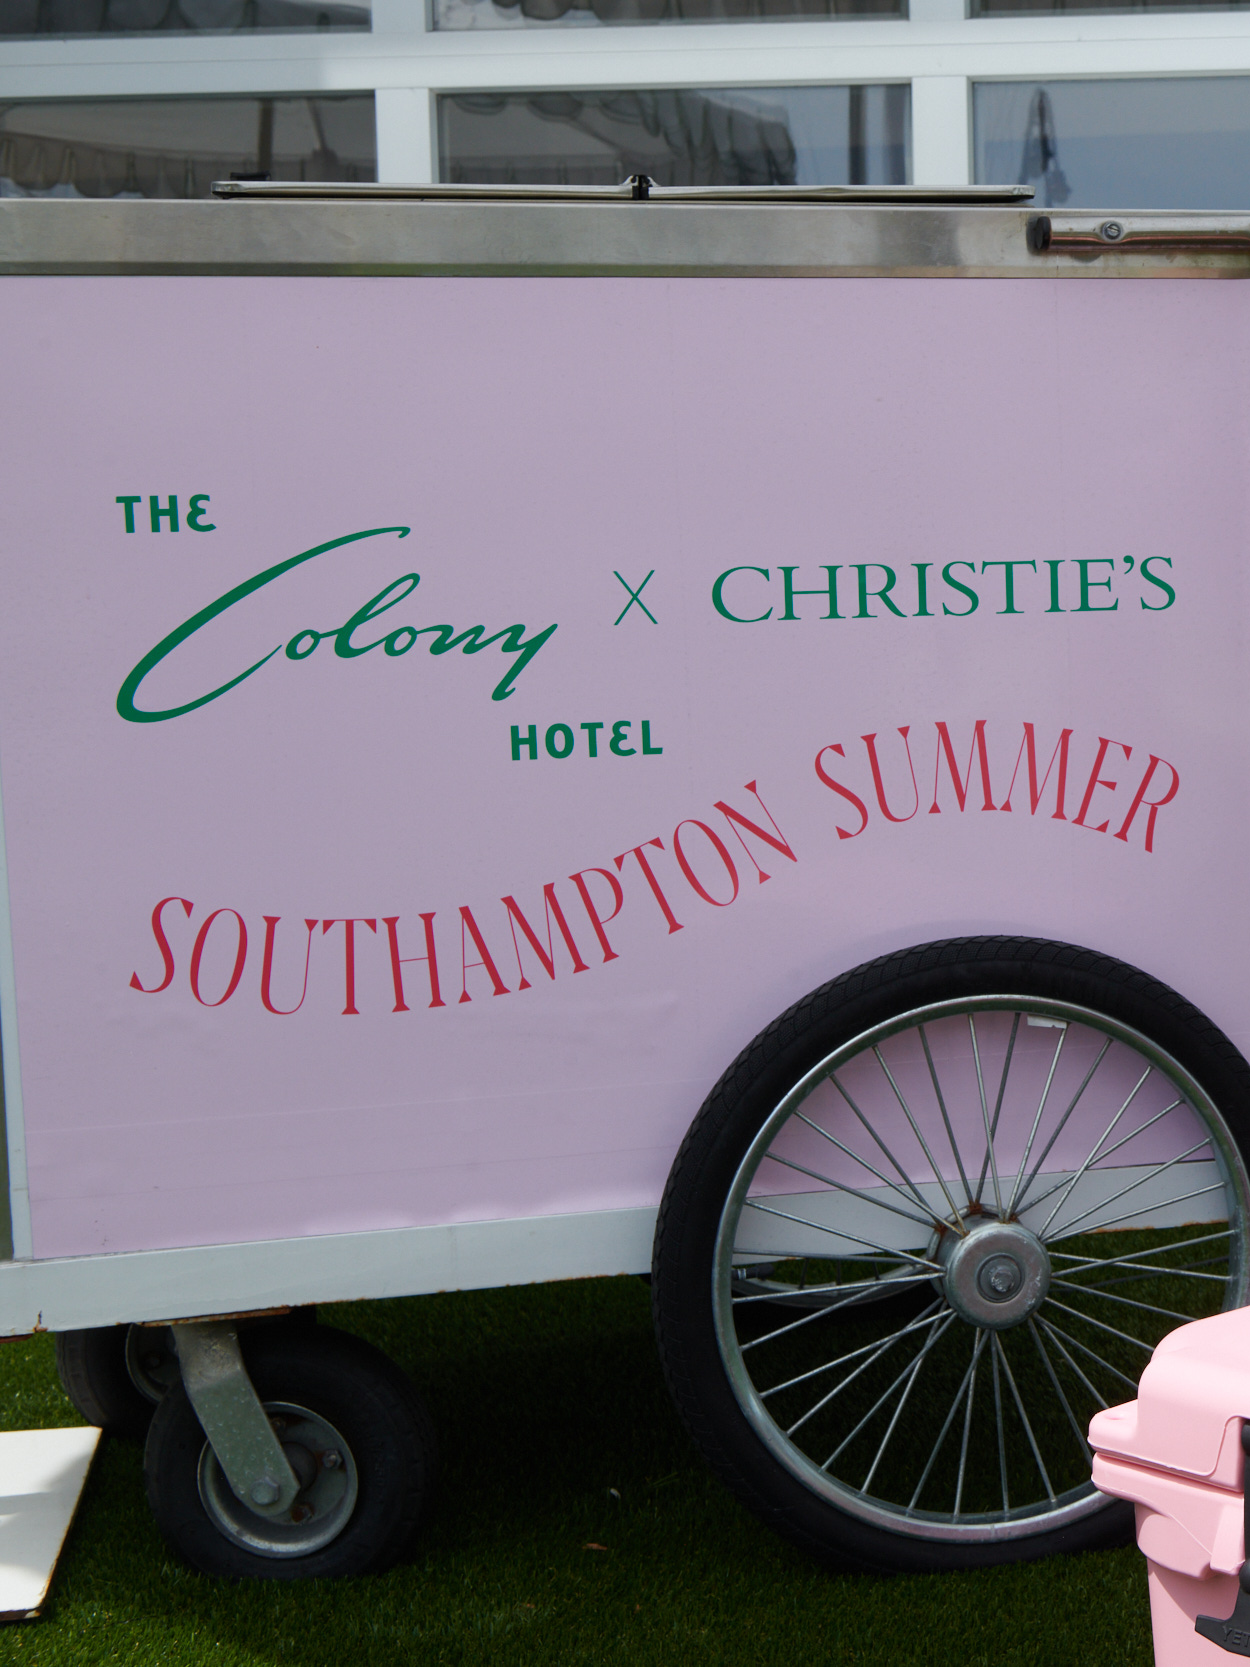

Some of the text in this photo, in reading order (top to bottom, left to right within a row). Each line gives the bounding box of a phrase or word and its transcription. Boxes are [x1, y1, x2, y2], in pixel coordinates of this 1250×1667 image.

[116, 494, 217, 533] THE
[116, 526, 1176, 723] Colony X CHRISTIE'S
[510, 720, 663, 761] HOTEL
[129, 719, 1180, 1015] SOUTHAMPTON SUMMER
